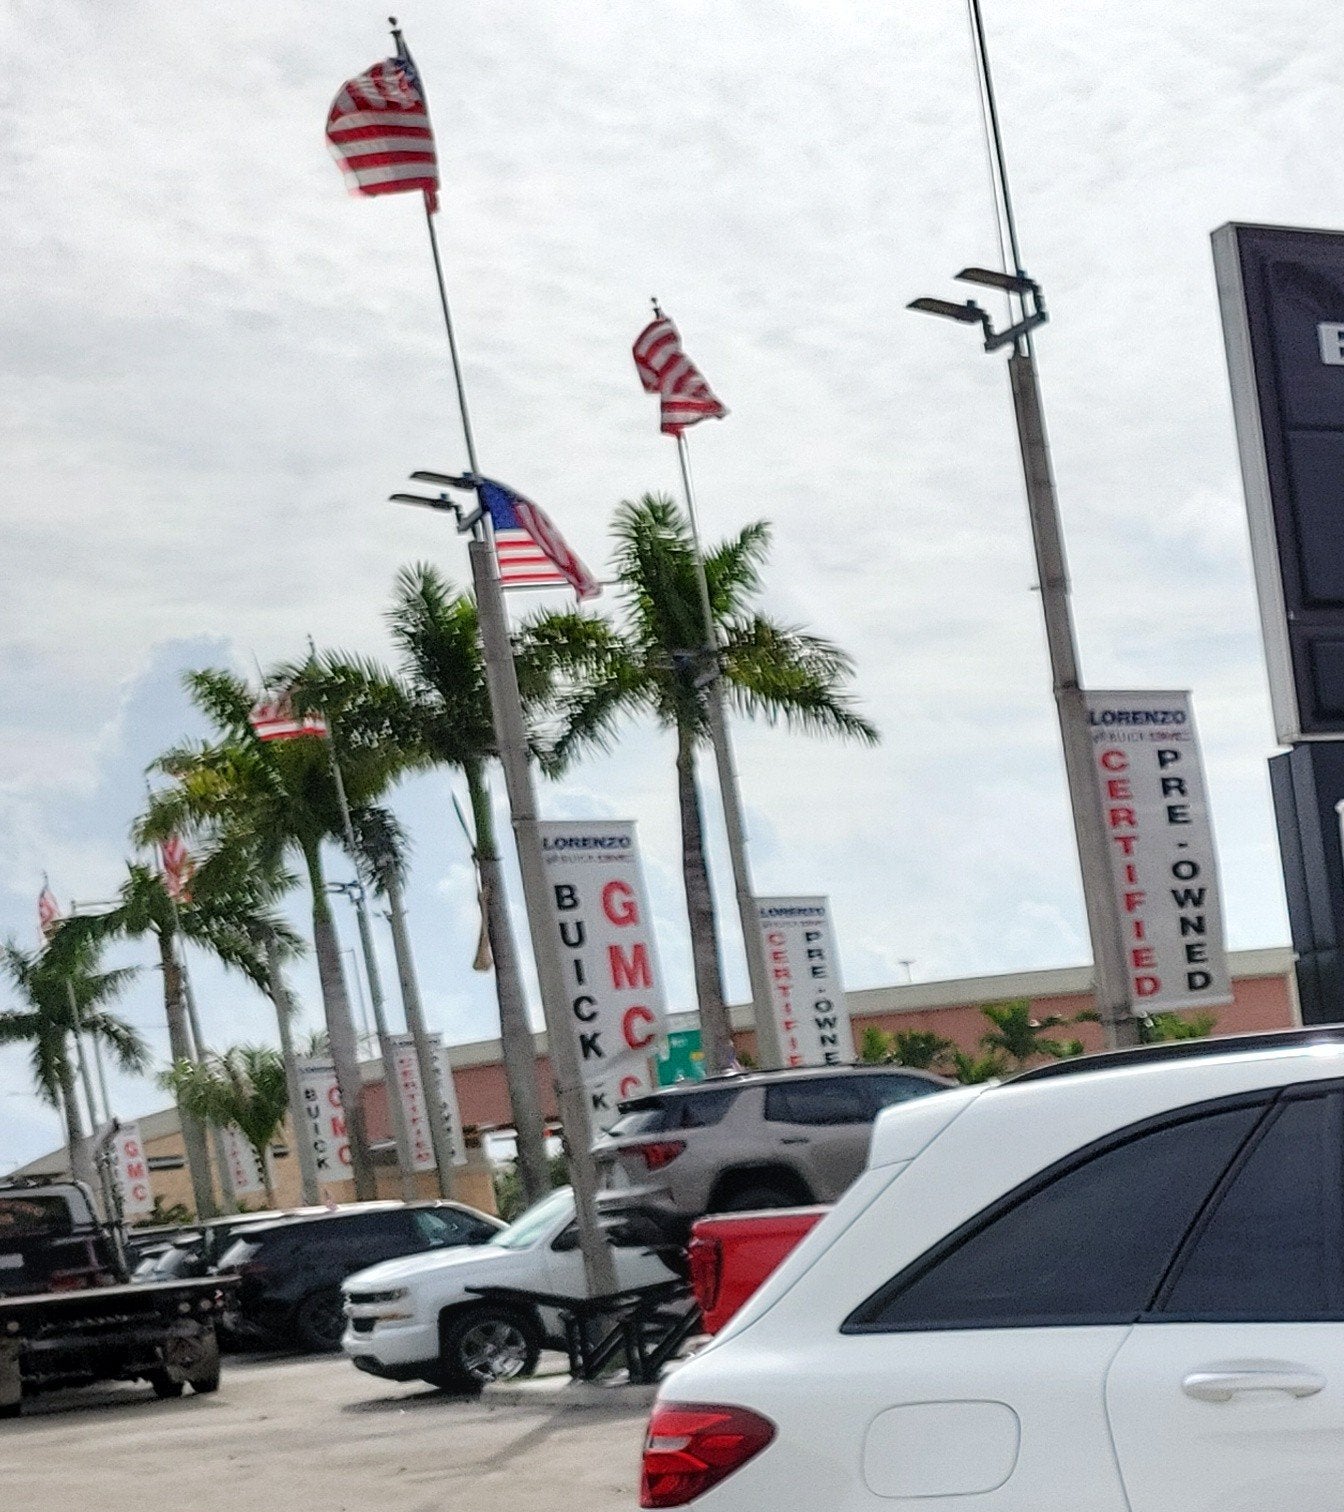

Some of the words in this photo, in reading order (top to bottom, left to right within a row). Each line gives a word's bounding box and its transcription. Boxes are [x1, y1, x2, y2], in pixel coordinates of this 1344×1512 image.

[1089, 710, 1187, 726] LORENZO
[542, 836, 632, 851] LORENZO
[1100, 750, 1161, 997] CERTIFIED
[1157, 749, 1212, 991] PRE-OWNED
[554, 884, 603, 1061] BUICK
[602, 880, 655, 1050] GMC
[768, 931, 802, 1067] CERTIFIE
[805, 931, 840, 1066] PRE-OWNE
